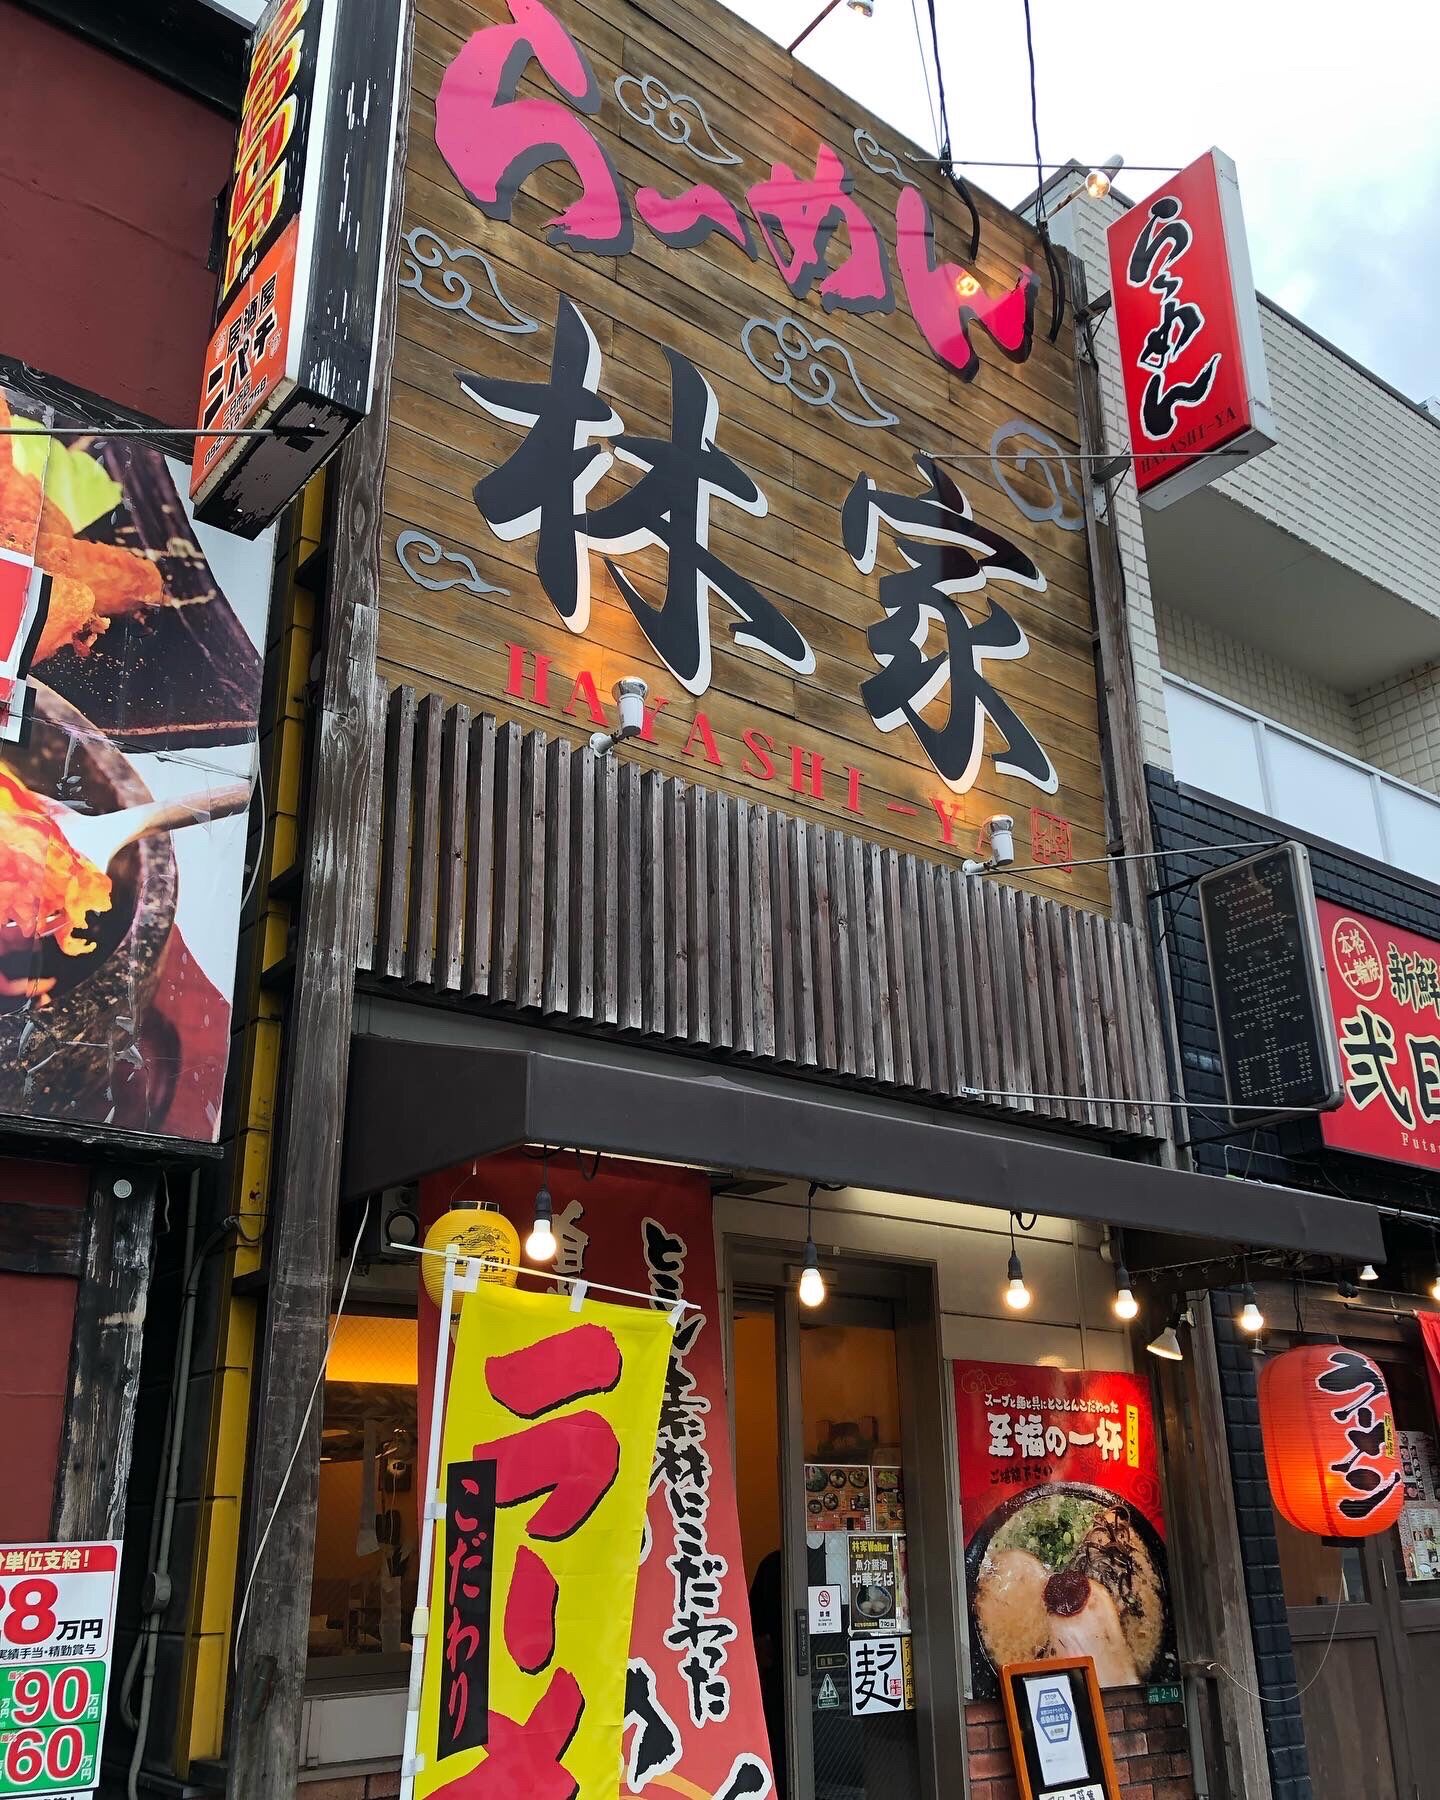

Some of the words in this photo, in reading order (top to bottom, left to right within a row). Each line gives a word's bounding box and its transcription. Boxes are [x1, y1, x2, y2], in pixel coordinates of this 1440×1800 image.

[434, 0, 1040, 385] らーめん
[227, 272, 277, 359] 居酒屋
[201, 306, 277, 440] ニパチ
[456, 294, 1056, 796] 林家
[505, 641, 992, 857] HAYASHI-Y
[1337, 929, 1366, 957] 本格
[1343, 956, 1381, 987] 七輪焼
[984, 1393, 1119, 1414] スープと麺と具にとことんこだわった
[987, 1412, 1124, 1461] 至福の一杯
[1128, 1410, 1137, 1461] ラーメン
[1316, 1352, 1401, 1519] ラーメン
[446, 1478, 487, 1741] こだわり
[851, 1572, 894, 1588] 中華そば
[0, 1578, 58, 1645] 8
[56, 1619, 104, 1641] 万円
[12, 1667, 91, 1725] 90
[87, 1693, 100, 1719] 万円
[1161, 1686, 1179, 1699] 2-10
[5, 1725, 85, 1784] 60
[80, 1755, 94, 1781] 万円
